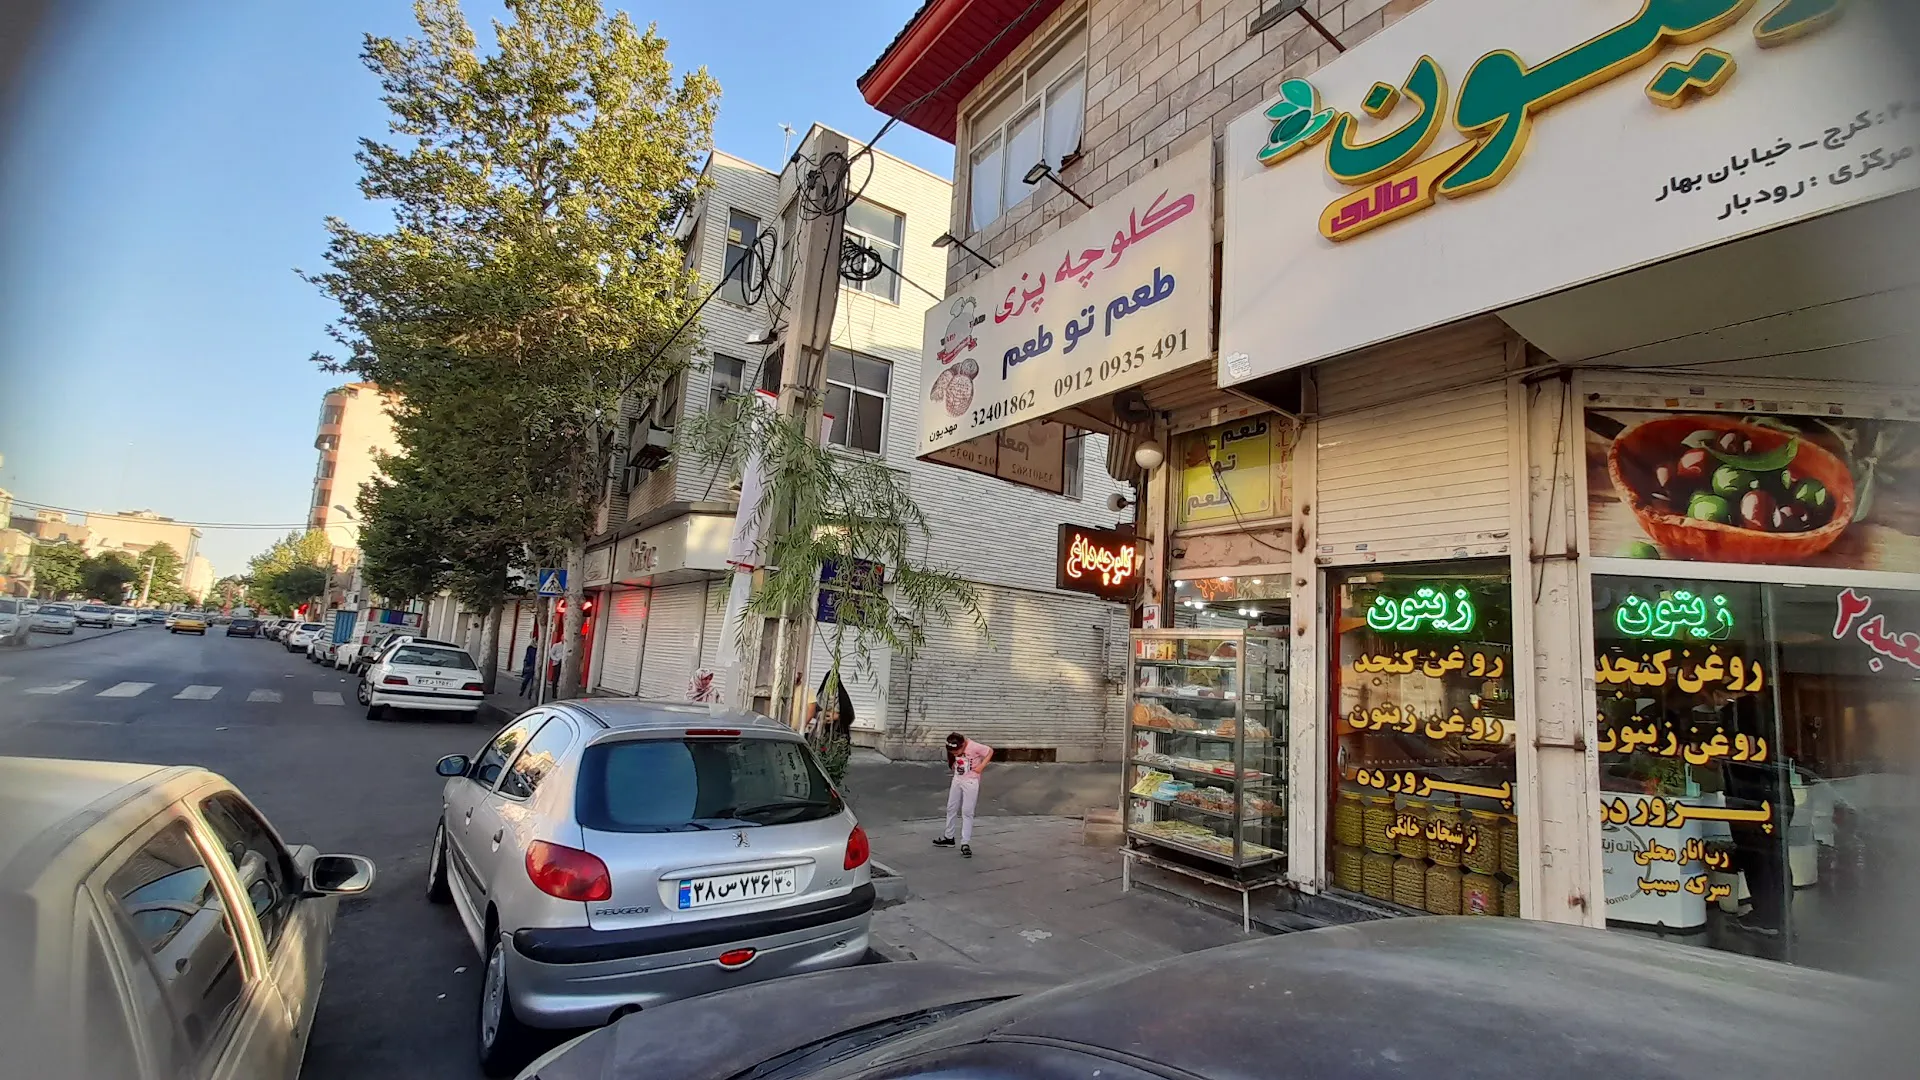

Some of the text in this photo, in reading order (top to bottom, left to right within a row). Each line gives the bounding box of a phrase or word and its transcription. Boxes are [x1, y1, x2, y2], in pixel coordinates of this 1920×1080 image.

[1823, 109, 1872, 149] کرج
[1707, 137, 1792, 184] خیابان
[1655, 174, 1703, 202] بهار
[1717, 179, 1804, 220] رودبار
[994, 188, 1195, 324] کلوچه پزی
[1001, 266, 1176, 380] طعم تو طعم
[970, 328, 1189, 428] 32401862 0912 0935 491
[1221, 418, 1268, 450] طعم
[1213, 454, 1237, 480] تو
[1366, 588, 1473, 631] زیتون
[1616, 590, 1734, 640] زیتون
[1423, 645, 1504, 677] روغن
[1857, 614, 1920, 672] عبه
[1354, 649, 1418, 686] کنجد
[1595, 649, 1672, 699] کنجد
[1678, 644, 1764, 693] روغن
[1349, 703, 1504, 741] روغن زیتون
[1597, 713, 1677, 755] زیتون
[1684, 727, 1767, 764] روغن
[1385, 815, 1420, 839] خانگی
[1634, 838, 1729, 870] رب انار محلی
[1637, 877, 1680, 896] سیب
[596, 906, 651, 915] PEUGEOT
